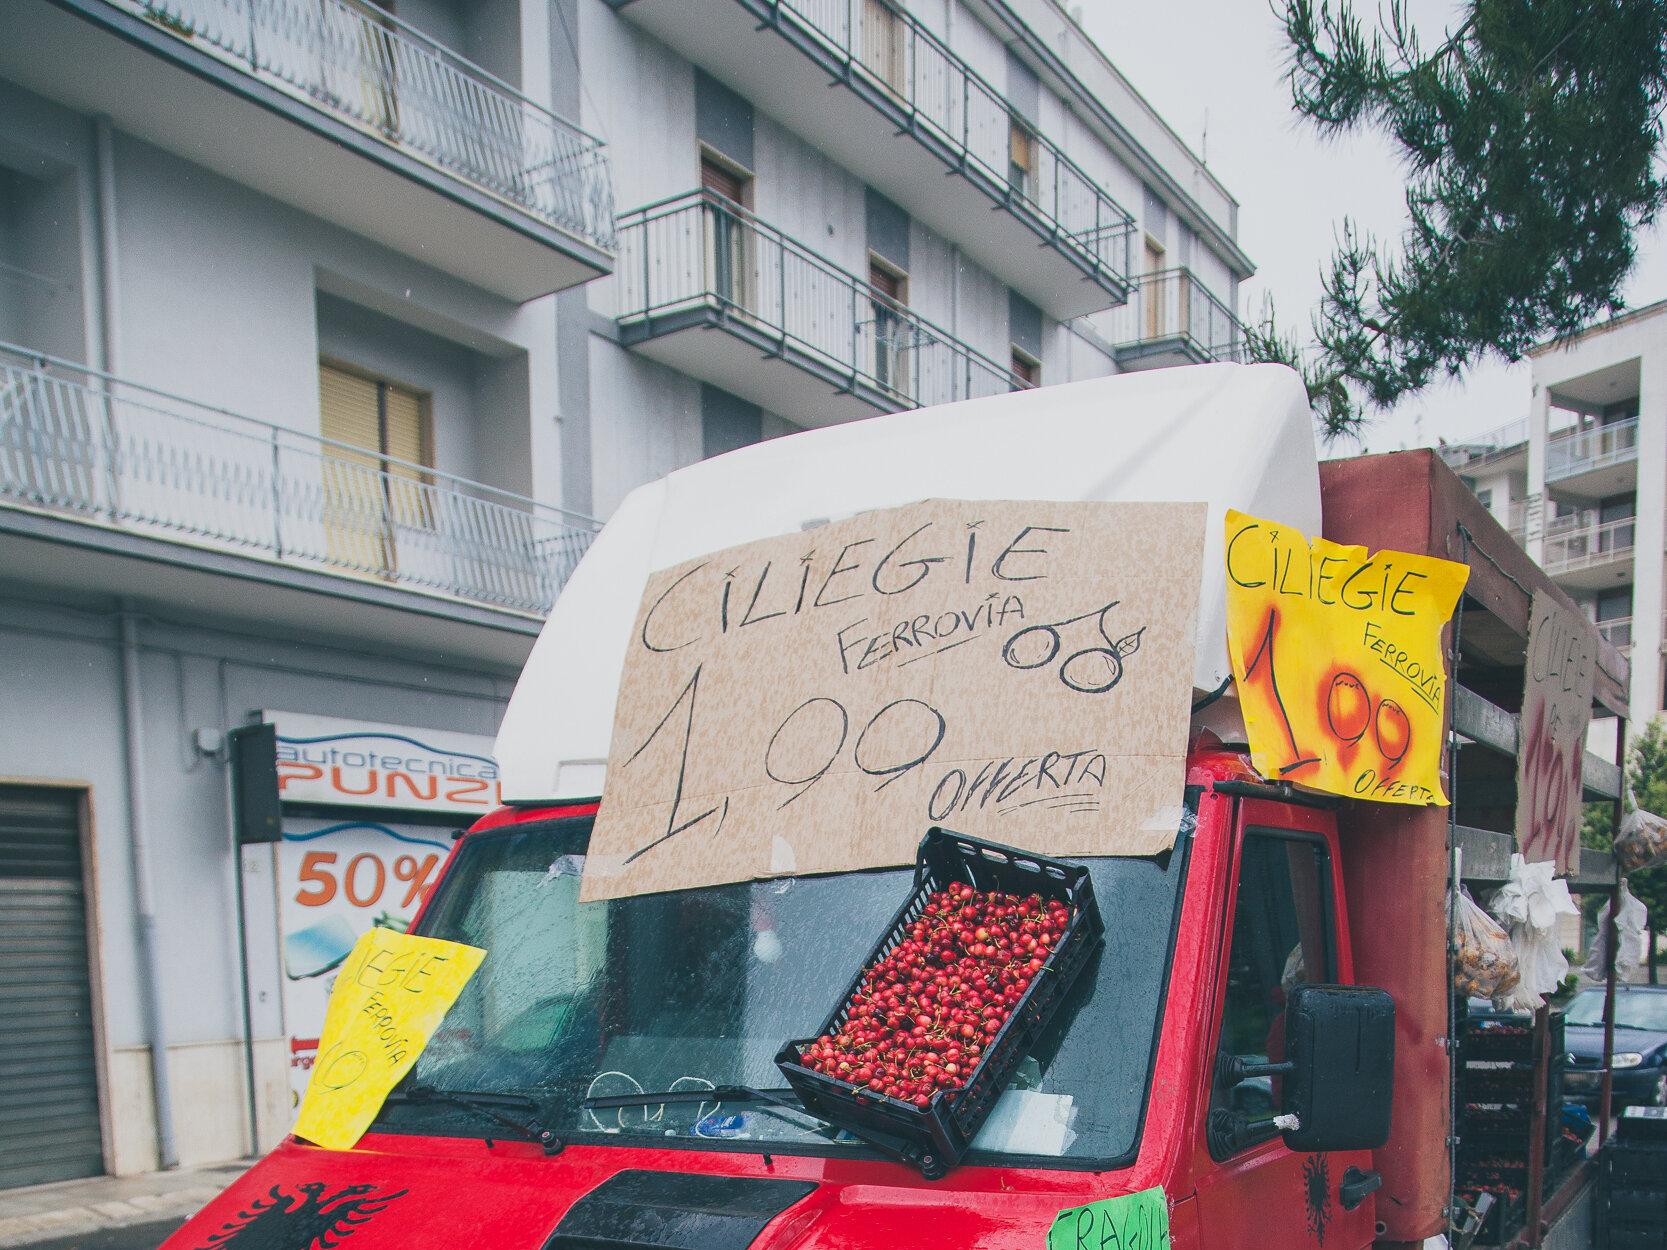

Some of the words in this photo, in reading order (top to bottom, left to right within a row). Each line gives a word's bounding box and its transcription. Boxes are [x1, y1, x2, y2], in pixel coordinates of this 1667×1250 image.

[642, 520, 1071, 652] CILIEGIE
[1228, 524, 1428, 616] CILIEGIE
[837, 592, 1026, 674] FERROVIA
[1362, 622, 1440, 708] FERROVIA
[276, 745, 499, 780] autotecnica
[928, 749, 1107, 821] OFFERTA
[295, 851, 439, 908] 50%
